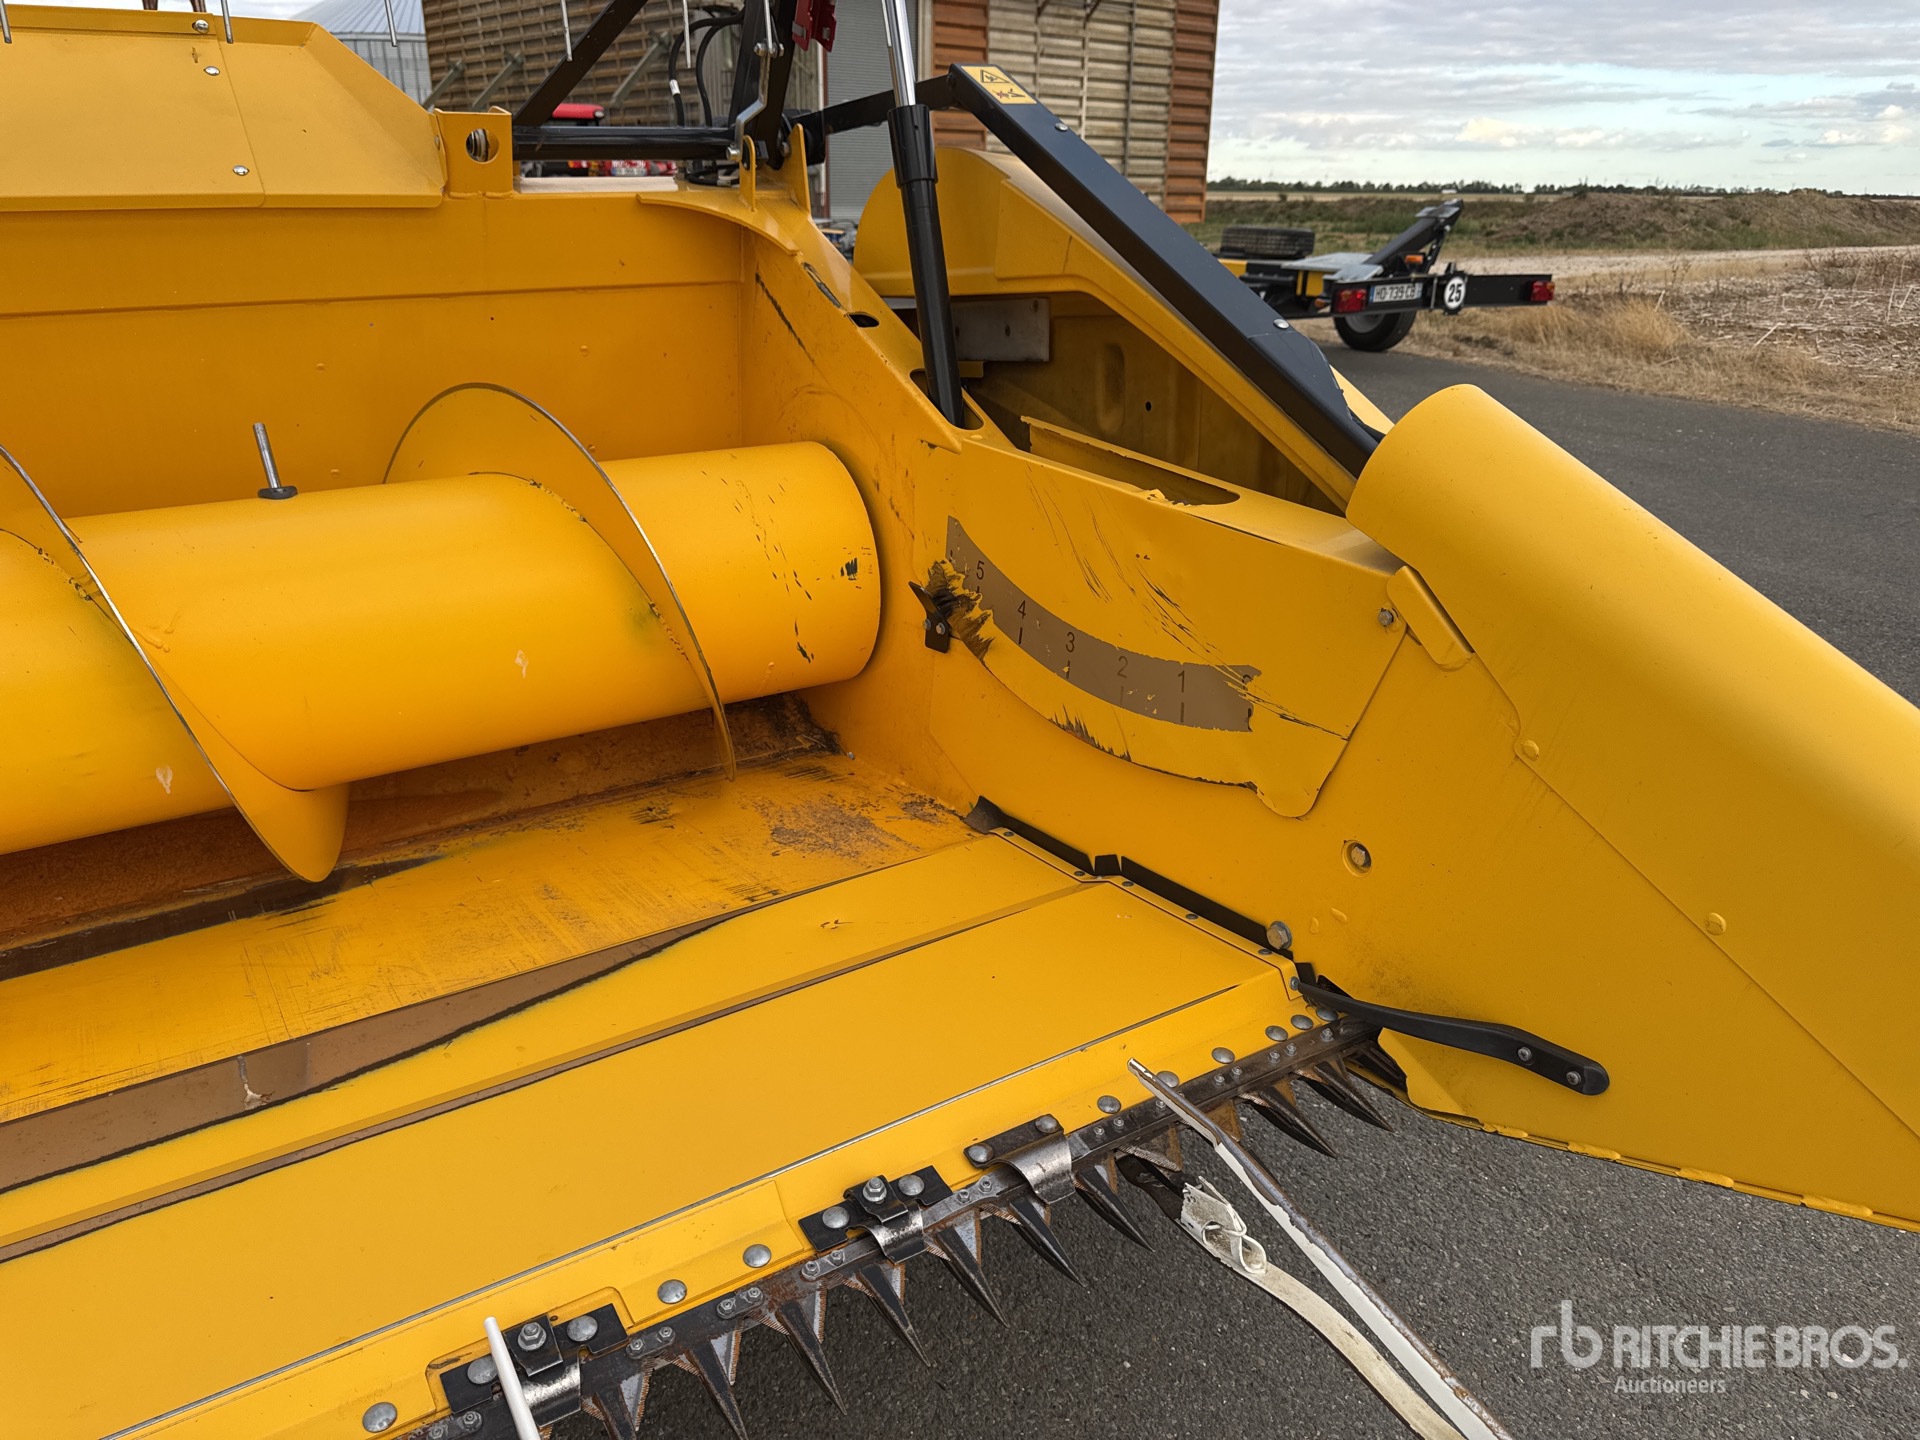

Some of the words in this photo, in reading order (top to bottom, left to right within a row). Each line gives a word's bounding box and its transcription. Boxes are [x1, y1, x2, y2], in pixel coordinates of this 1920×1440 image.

[1447, 283, 1463, 303] 25
[976, 560, 985, 580] 5
[1017, 600, 1027, 620] 4
[1065, 631, 1075, 653] 3
[1117, 655, 1128, 678] 2
[1178, 670, 1185, 693] 1
